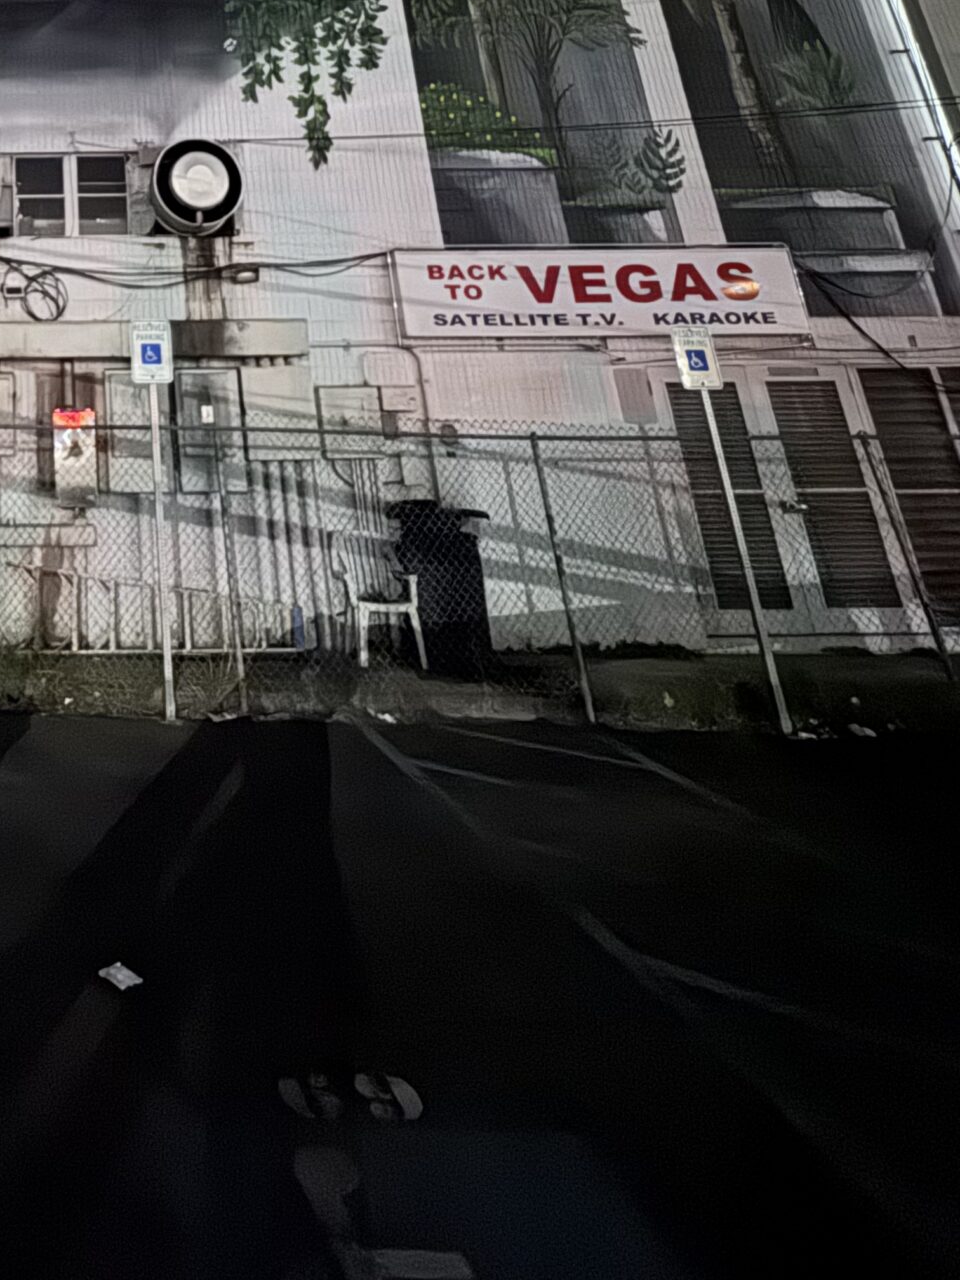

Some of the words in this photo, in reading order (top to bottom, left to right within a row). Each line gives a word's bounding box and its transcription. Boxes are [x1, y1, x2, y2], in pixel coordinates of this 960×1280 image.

[426, 264, 508, 281] BACK
[514, 261, 761, 304] VEGAS
[443, 284, 483, 300] TO
[432, 313, 570, 327] SATELLITE
[575, 313, 624, 327] T.V.
[652, 311, 778, 326] KARAOKE
[135, 333, 165, 341] PARKING
